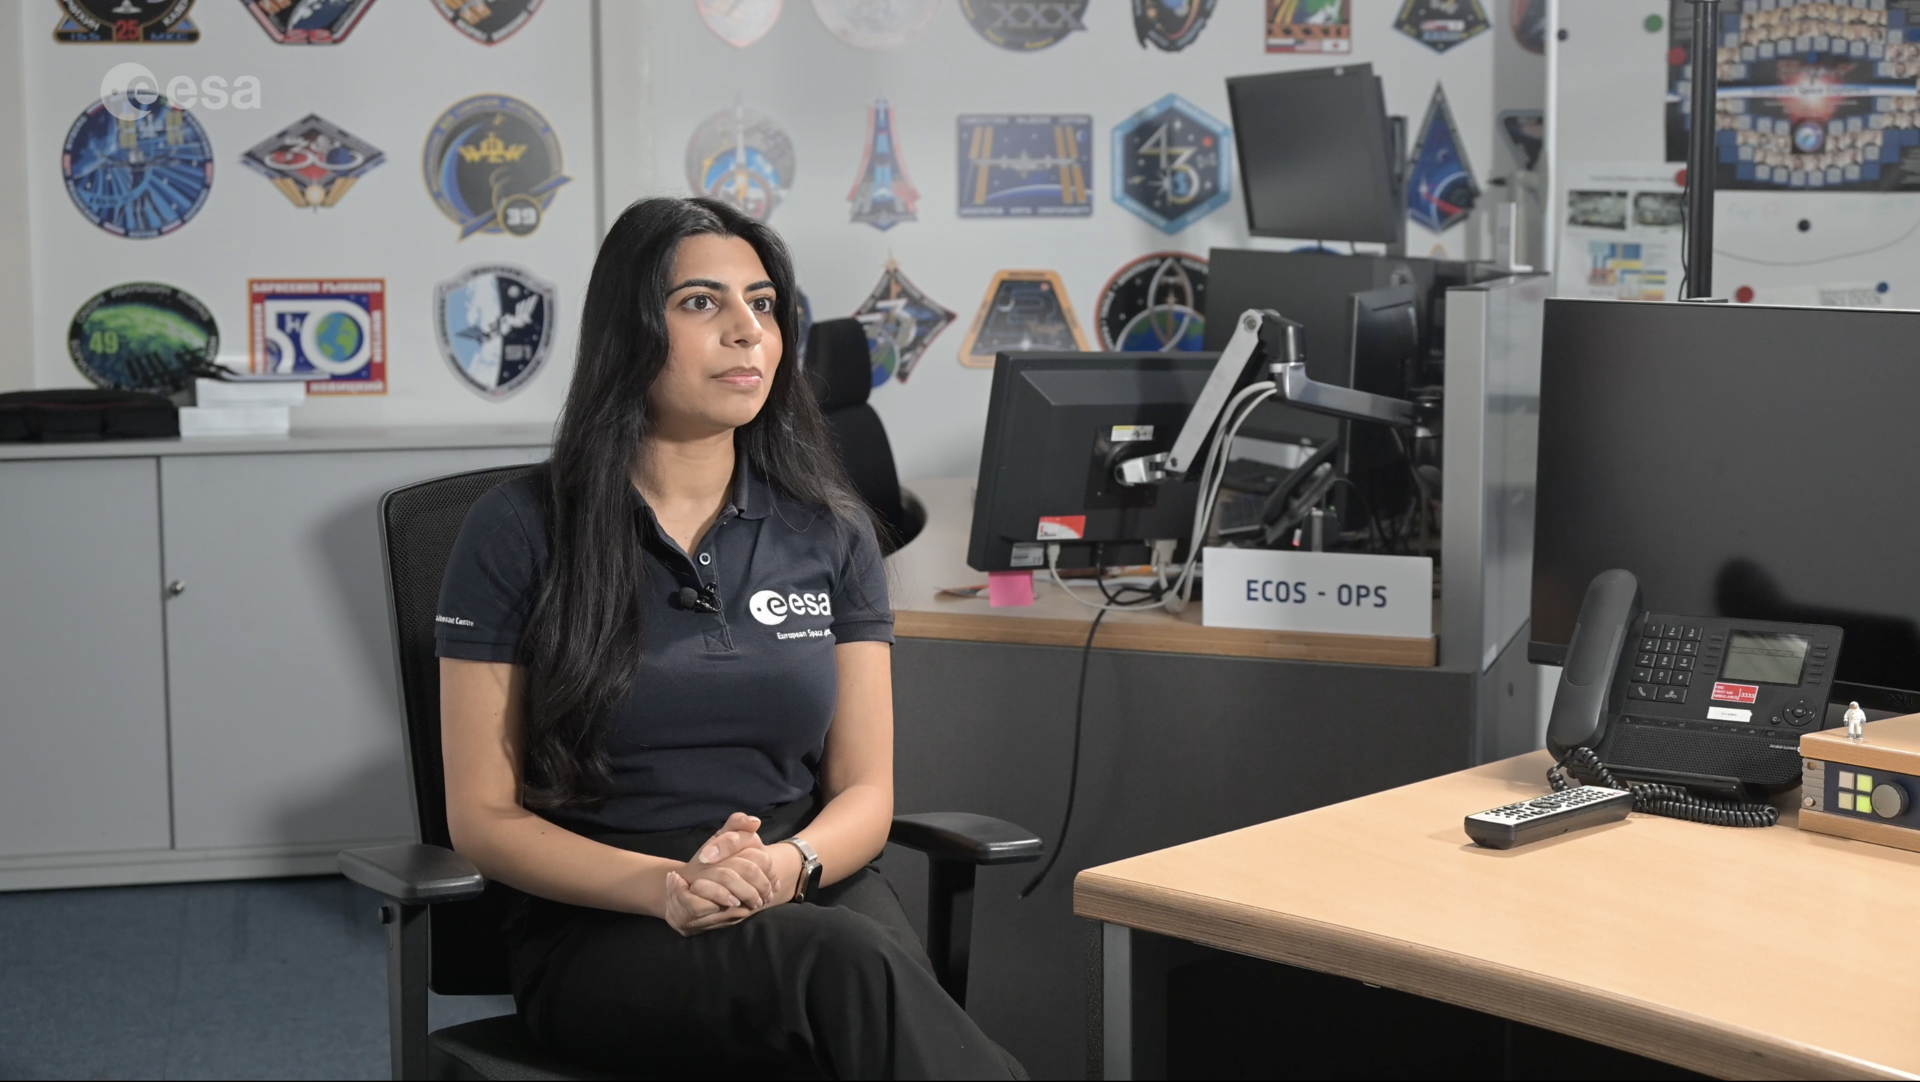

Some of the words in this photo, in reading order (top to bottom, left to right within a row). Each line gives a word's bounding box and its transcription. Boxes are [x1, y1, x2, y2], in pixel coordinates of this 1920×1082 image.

[115, 19, 141, 40] 25
[506, 207, 537, 226] 39
[88, 330, 119, 355] 49
[1246, 579, 1307, 604] ECOS
[1337, 583, 1388, 608] OPS
[776, 630, 807, 640] European
[807, 628, 823, 638] Space
